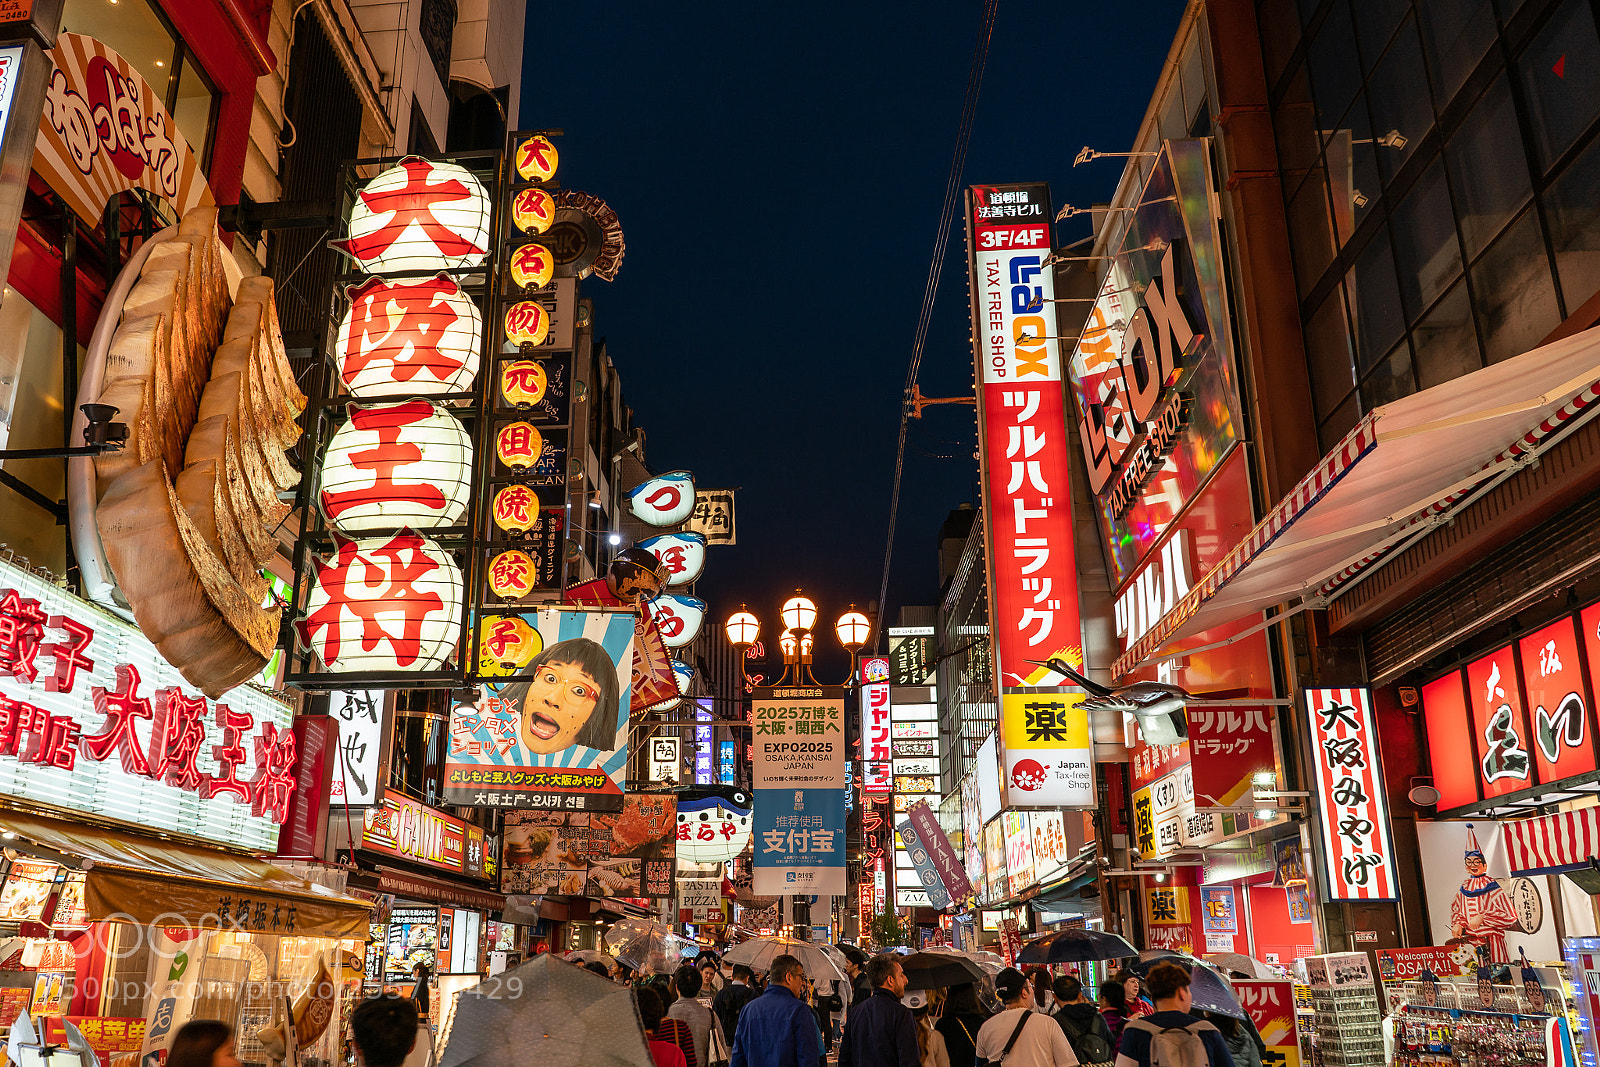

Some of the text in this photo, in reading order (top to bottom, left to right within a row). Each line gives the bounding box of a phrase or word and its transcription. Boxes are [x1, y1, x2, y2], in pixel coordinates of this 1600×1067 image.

[990, 191, 1028, 205] 道頓堀
[978, 204, 1042, 218] 法善寺ビル
[980, 229, 1044, 248] 3F/4F
[986, 259, 1006, 378] TAX FREE SHOP
[291, 155, 490, 668] 大阪王将
[1107, 391, 1183, 519] TAX FREE SHOP
[1001, 390, 1060, 646] ツルハドラッグ
[1114, 529, 1192, 652] ツルハ
[756, 706, 839, 720] 2025万博を
[1024, 702, 1068, 742] 薬
[1190, 710, 1269, 734] ツルハ
[453, 716, 518, 735] エンタメ
[756, 720, 841, 736] 大阪・関西へ
[79, 663, 298, 826] 大阪王将
[870, 687, 890, 784] ジャンカラ
[449, 736, 517, 757] ショップ
[764, 742, 833, 753] EXPO2025
[1193, 738, 1255, 756] ドラッグ
[783, 762, 814, 770] JAPAN
[1057, 760, 1089, 771] Japan.
[1053, 771, 1090, 780] Tax-free
[1067, 780, 1091, 791] Shop
[1156, 781, 1176, 808] くすり
[1319, 700, 1384, 886] 大阪みやげ
[775, 815, 823, 827] 推荐使用
[762, 828, 835, 854] 支付宝
[929, 834, 961, 885] ZAZA
[682, 880, 719, 891] PASTA
[683, 896, 719, 906] PIZZA
[215, 896, 297, 934] 道頓堀本店
[1395, 950, 1445, 962] Welcome to
[1396, 961, 1452, 976] OSAKA!!
